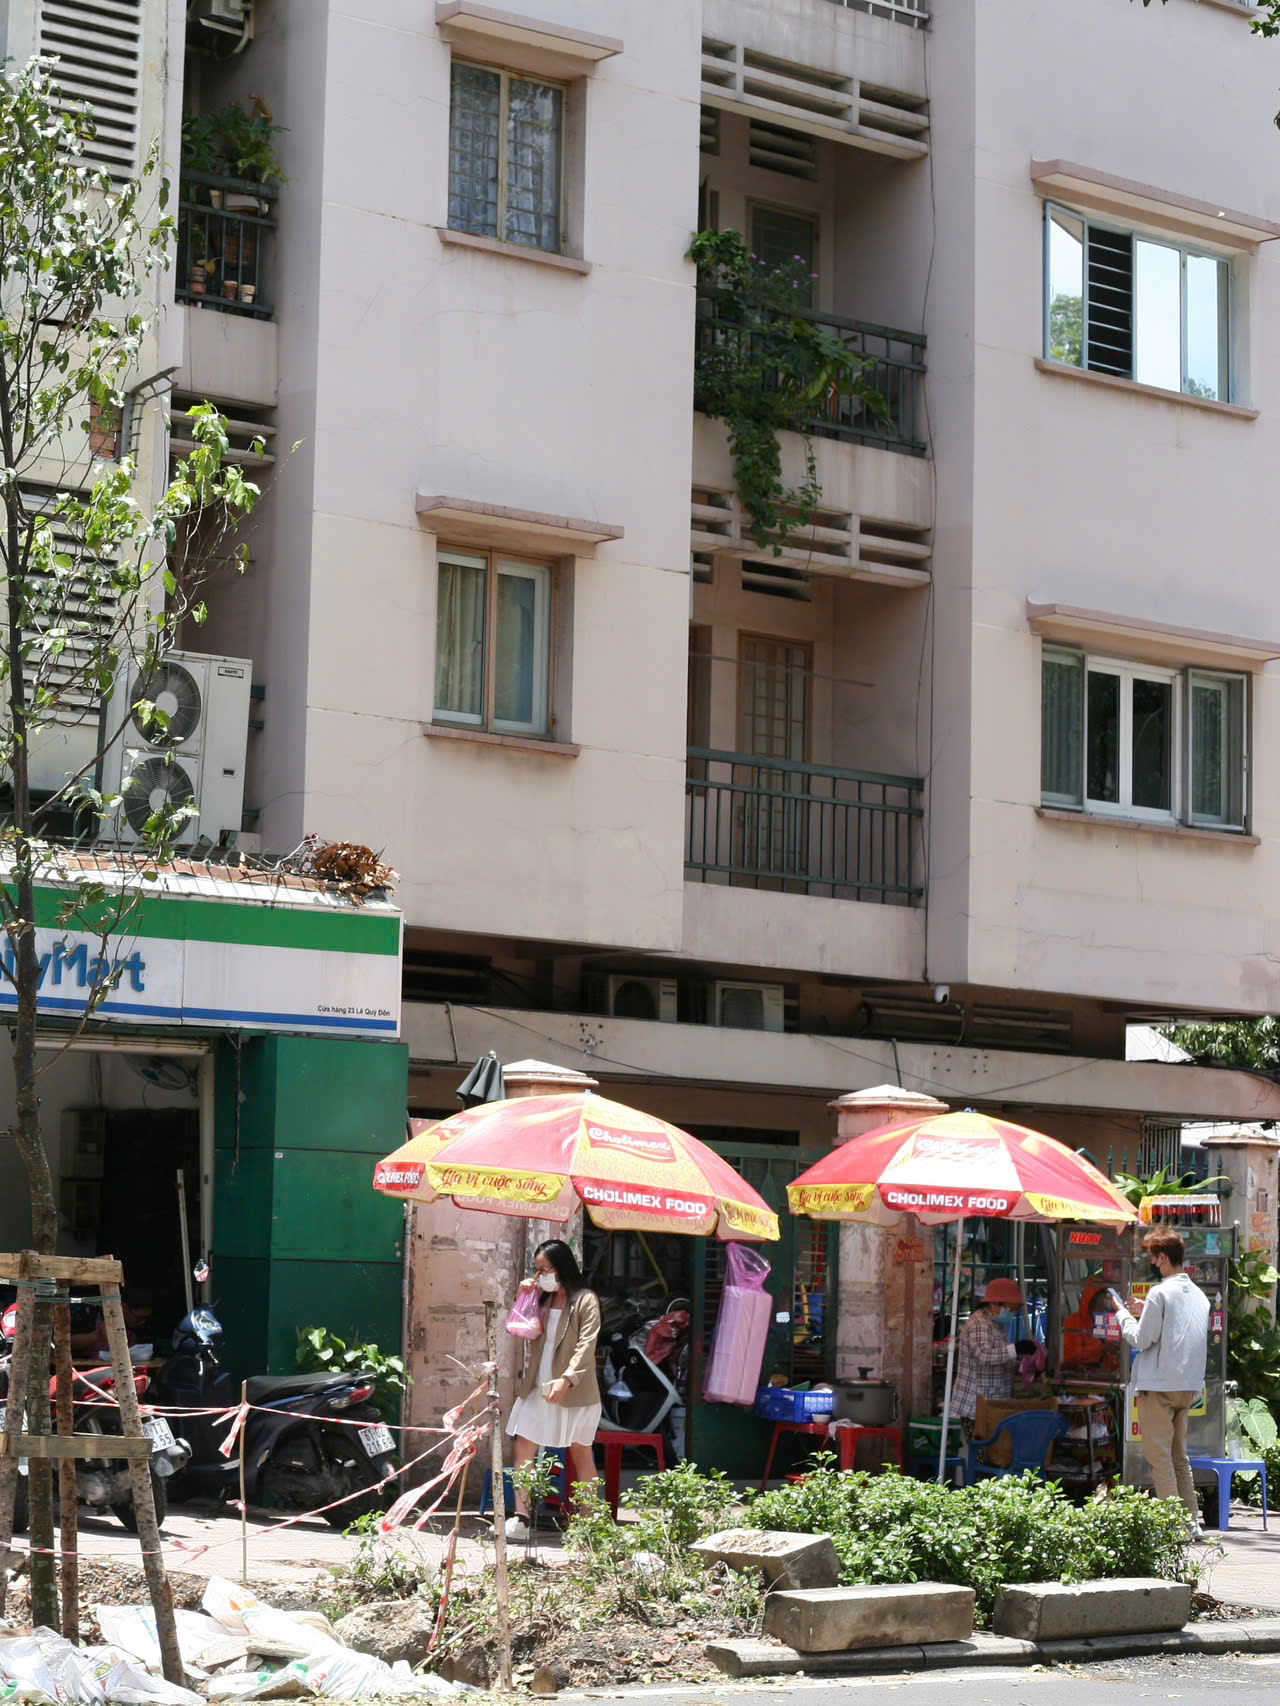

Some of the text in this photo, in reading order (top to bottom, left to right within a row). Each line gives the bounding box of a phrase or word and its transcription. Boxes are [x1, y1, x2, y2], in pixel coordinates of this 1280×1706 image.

[331, 1005, 347, 1015] hàng
[347, 1006, 355, 1014] 23
[355, 1007, 364, 1015] Lê
[377, 1009, 391, 1018] Đôn
[588, 1126, 672, 1152] Cholimex
[440, 1167, 549, 1198] Gia vị cuộc sống
[583, 1185, 707, 1216] CHOLIMEX FOOD
[887, 1191, 1009, 1212] CHOLIMEX FOOD
